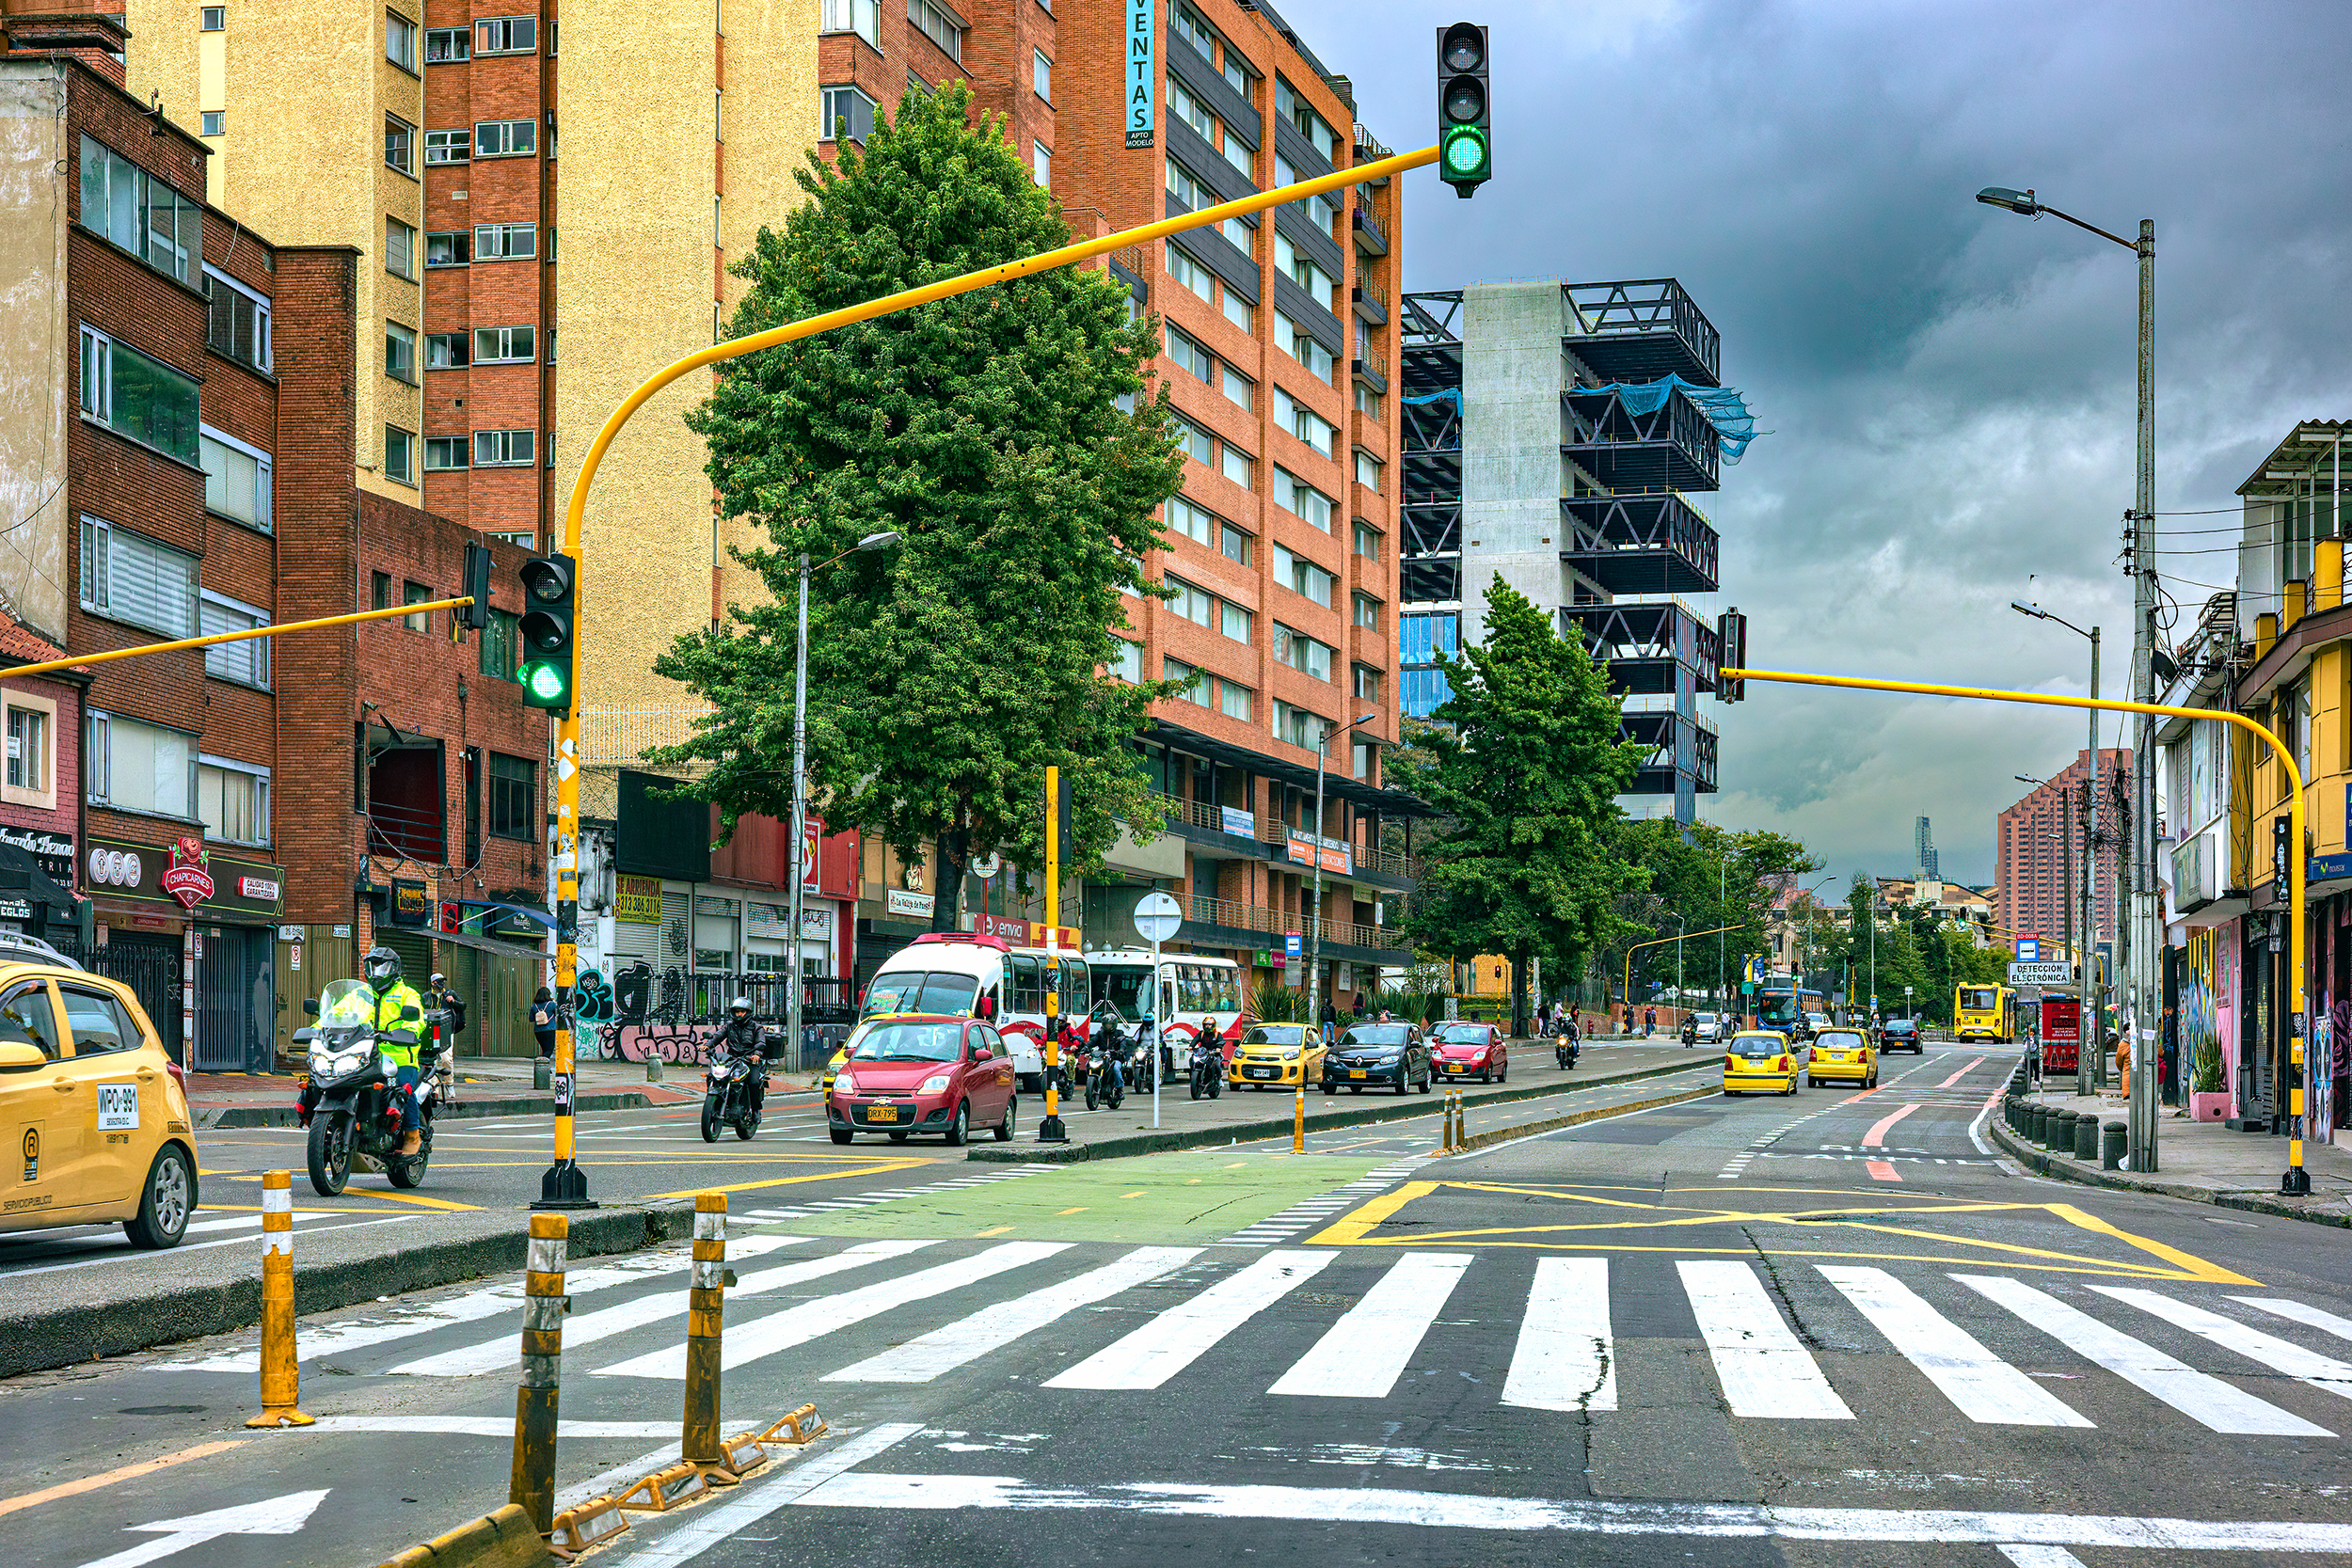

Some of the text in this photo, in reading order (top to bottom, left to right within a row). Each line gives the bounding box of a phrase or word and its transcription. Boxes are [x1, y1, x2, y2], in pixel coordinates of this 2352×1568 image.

[1125, 138, 1154, 147] MODELO
[170, 872, 210, 890] CHAPICARNES
[246, 879, 264, 889] CALIDAD
[246, 887, 275, 897] GARANTIZADA
[626, 878, 660, 898] ARRIENDA
[2017, 963, 2062, 973] DETECCIÓN
[2012, 973, 2067, 982] ELECTRÓNICA
